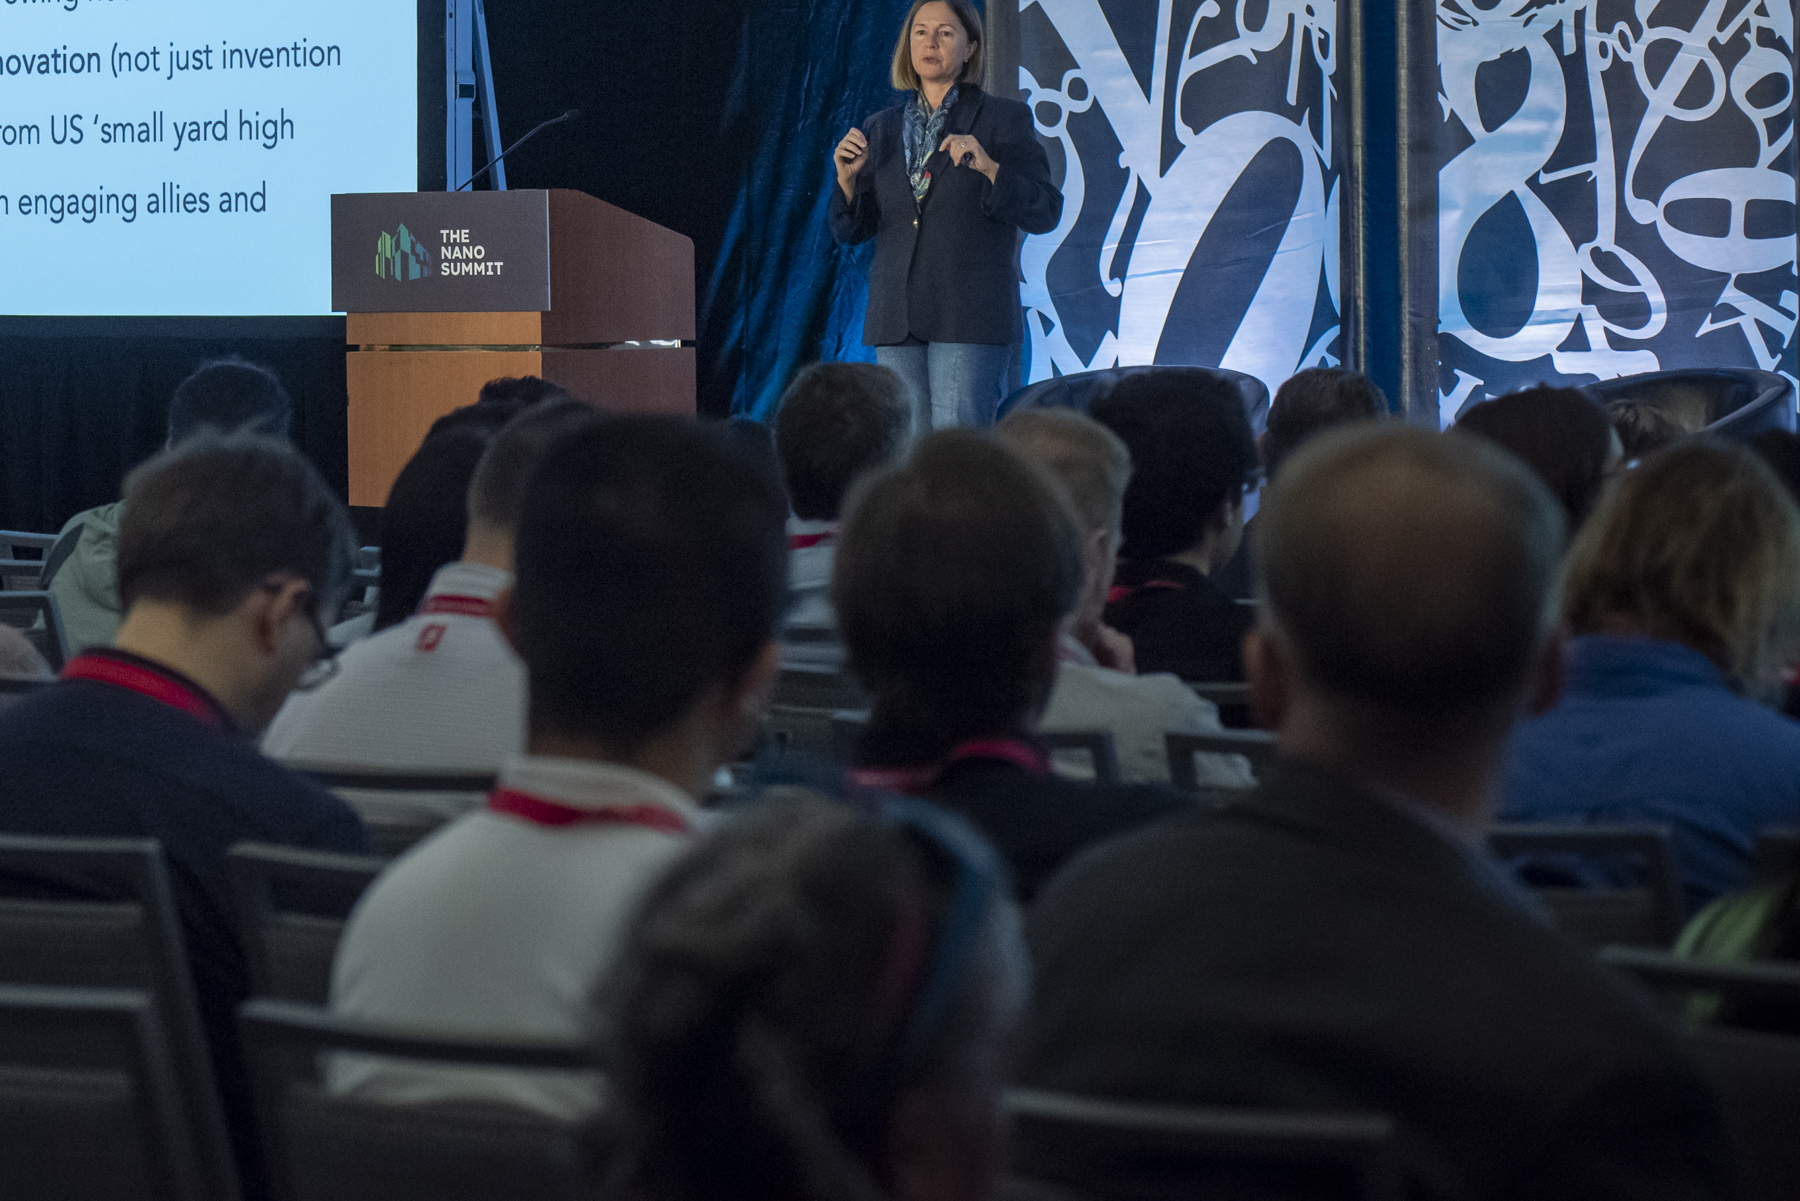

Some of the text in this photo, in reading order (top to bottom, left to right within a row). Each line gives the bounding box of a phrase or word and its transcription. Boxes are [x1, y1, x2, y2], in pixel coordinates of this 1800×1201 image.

[110, 41, 161, 79] (not
[166, 41, 214, 81] just
[222, 37, 341, 70] invention
[50, 113, 84, 145] US
[172, 108, 228, 152] yard
[239, 107, 294, 150] high
[18, 184, 137, 225] engaging
[146, 181, 211, 215] allies
[218, 179, 267, 214] and
[439, 229, 470, 244] THE
[440, 245, 486, 260] NANO
[440, 261, 504, 276] SUMMIT
